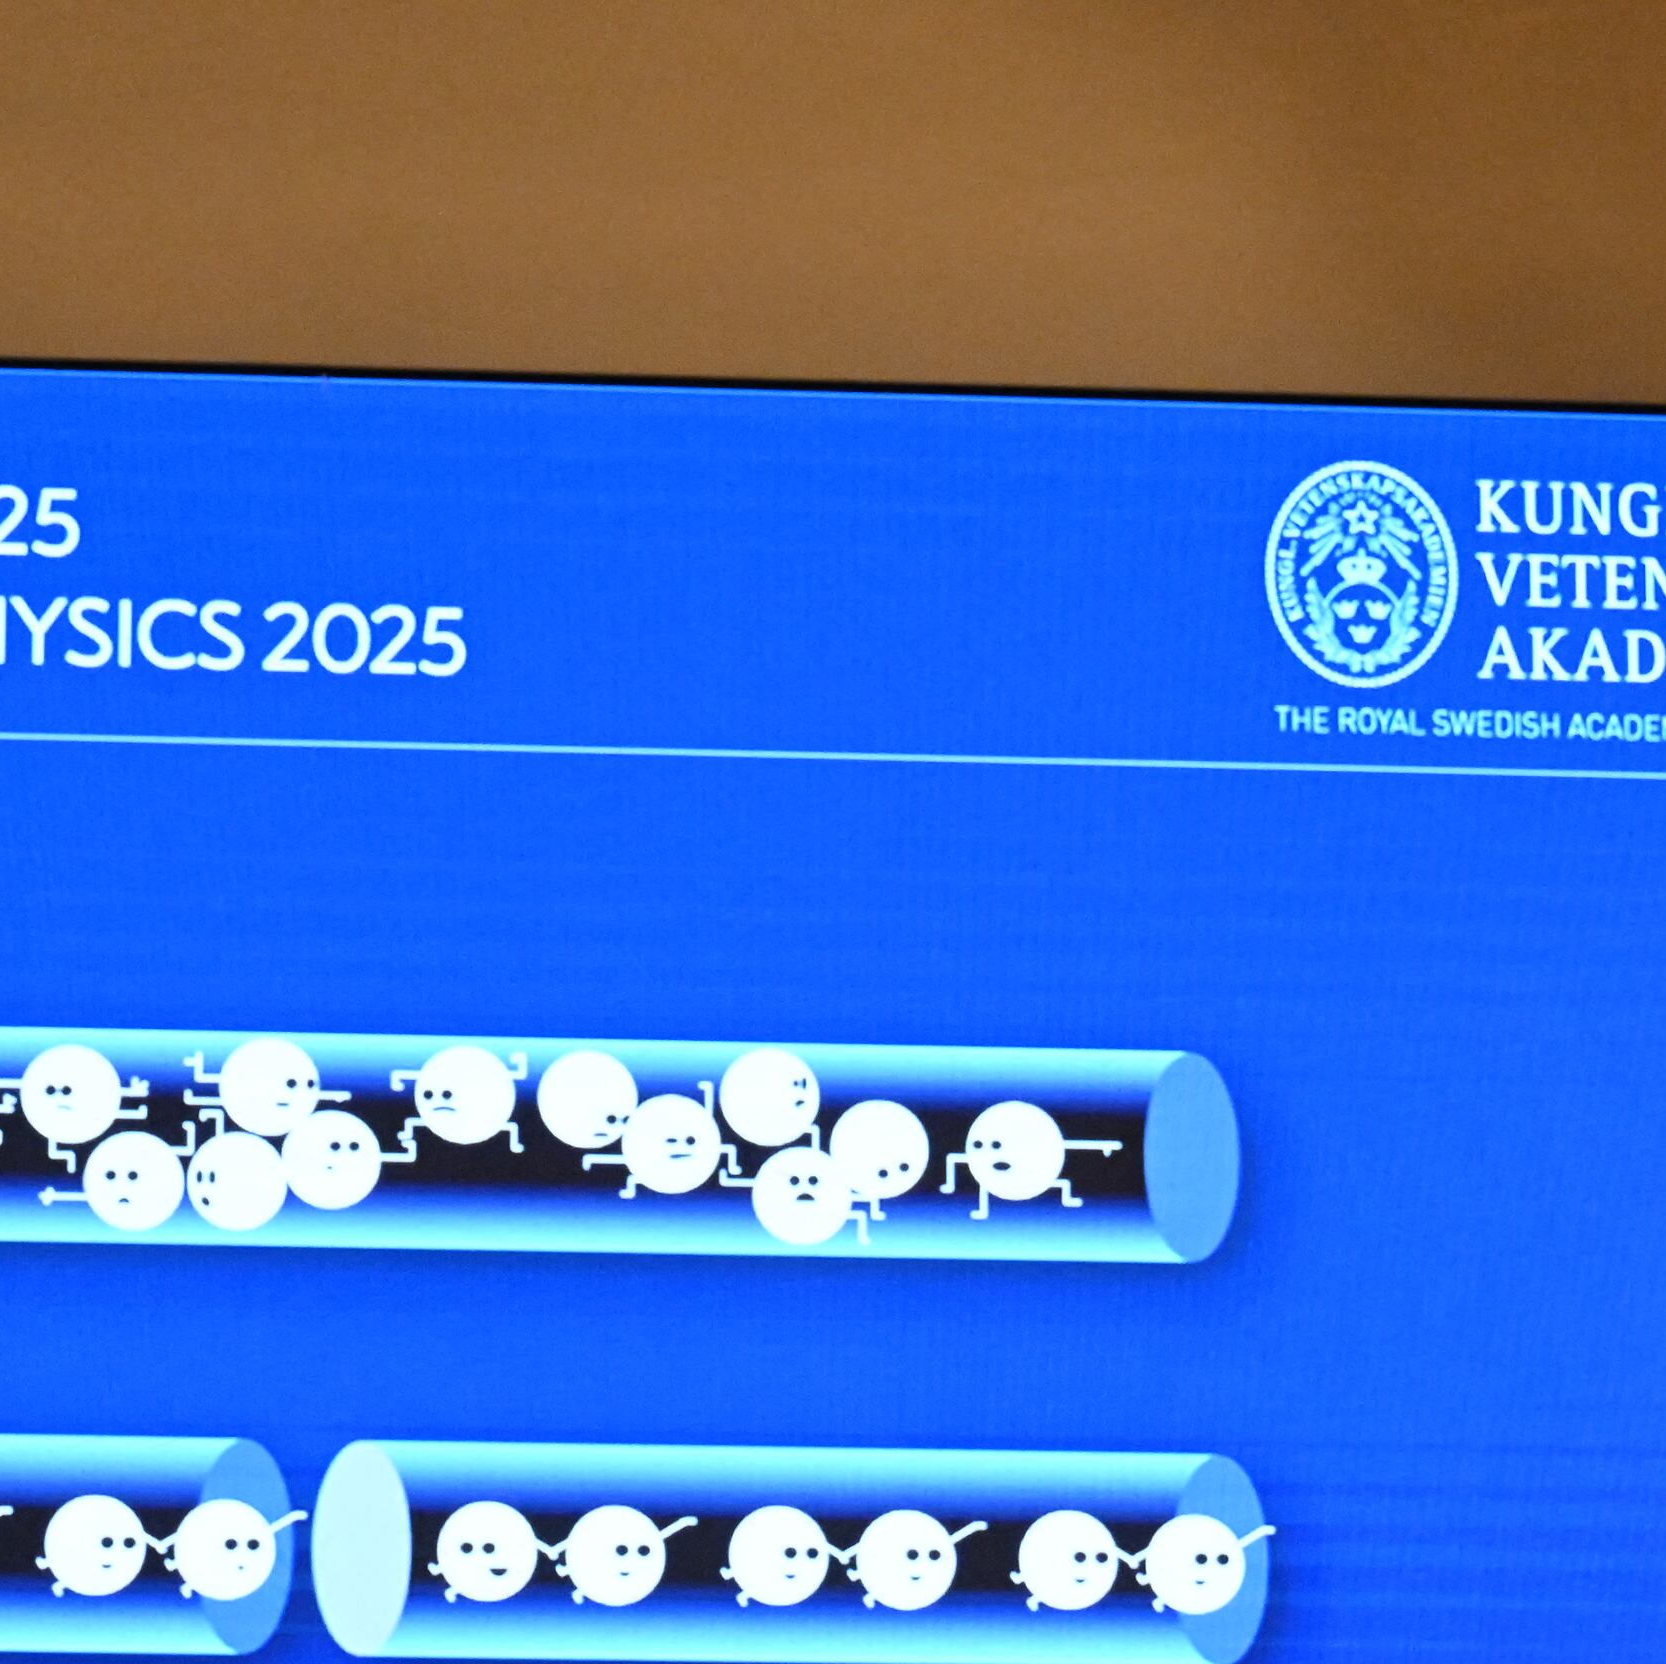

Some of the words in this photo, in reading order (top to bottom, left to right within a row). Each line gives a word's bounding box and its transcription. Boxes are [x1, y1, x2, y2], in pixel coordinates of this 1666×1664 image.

[260, 600, 468, 678] 2025
[1274, 704, 1329, 734] THE
[1338, 706, 1426, 737] ROYAL
[1432, 708, 1560, 739] SWEDISH
